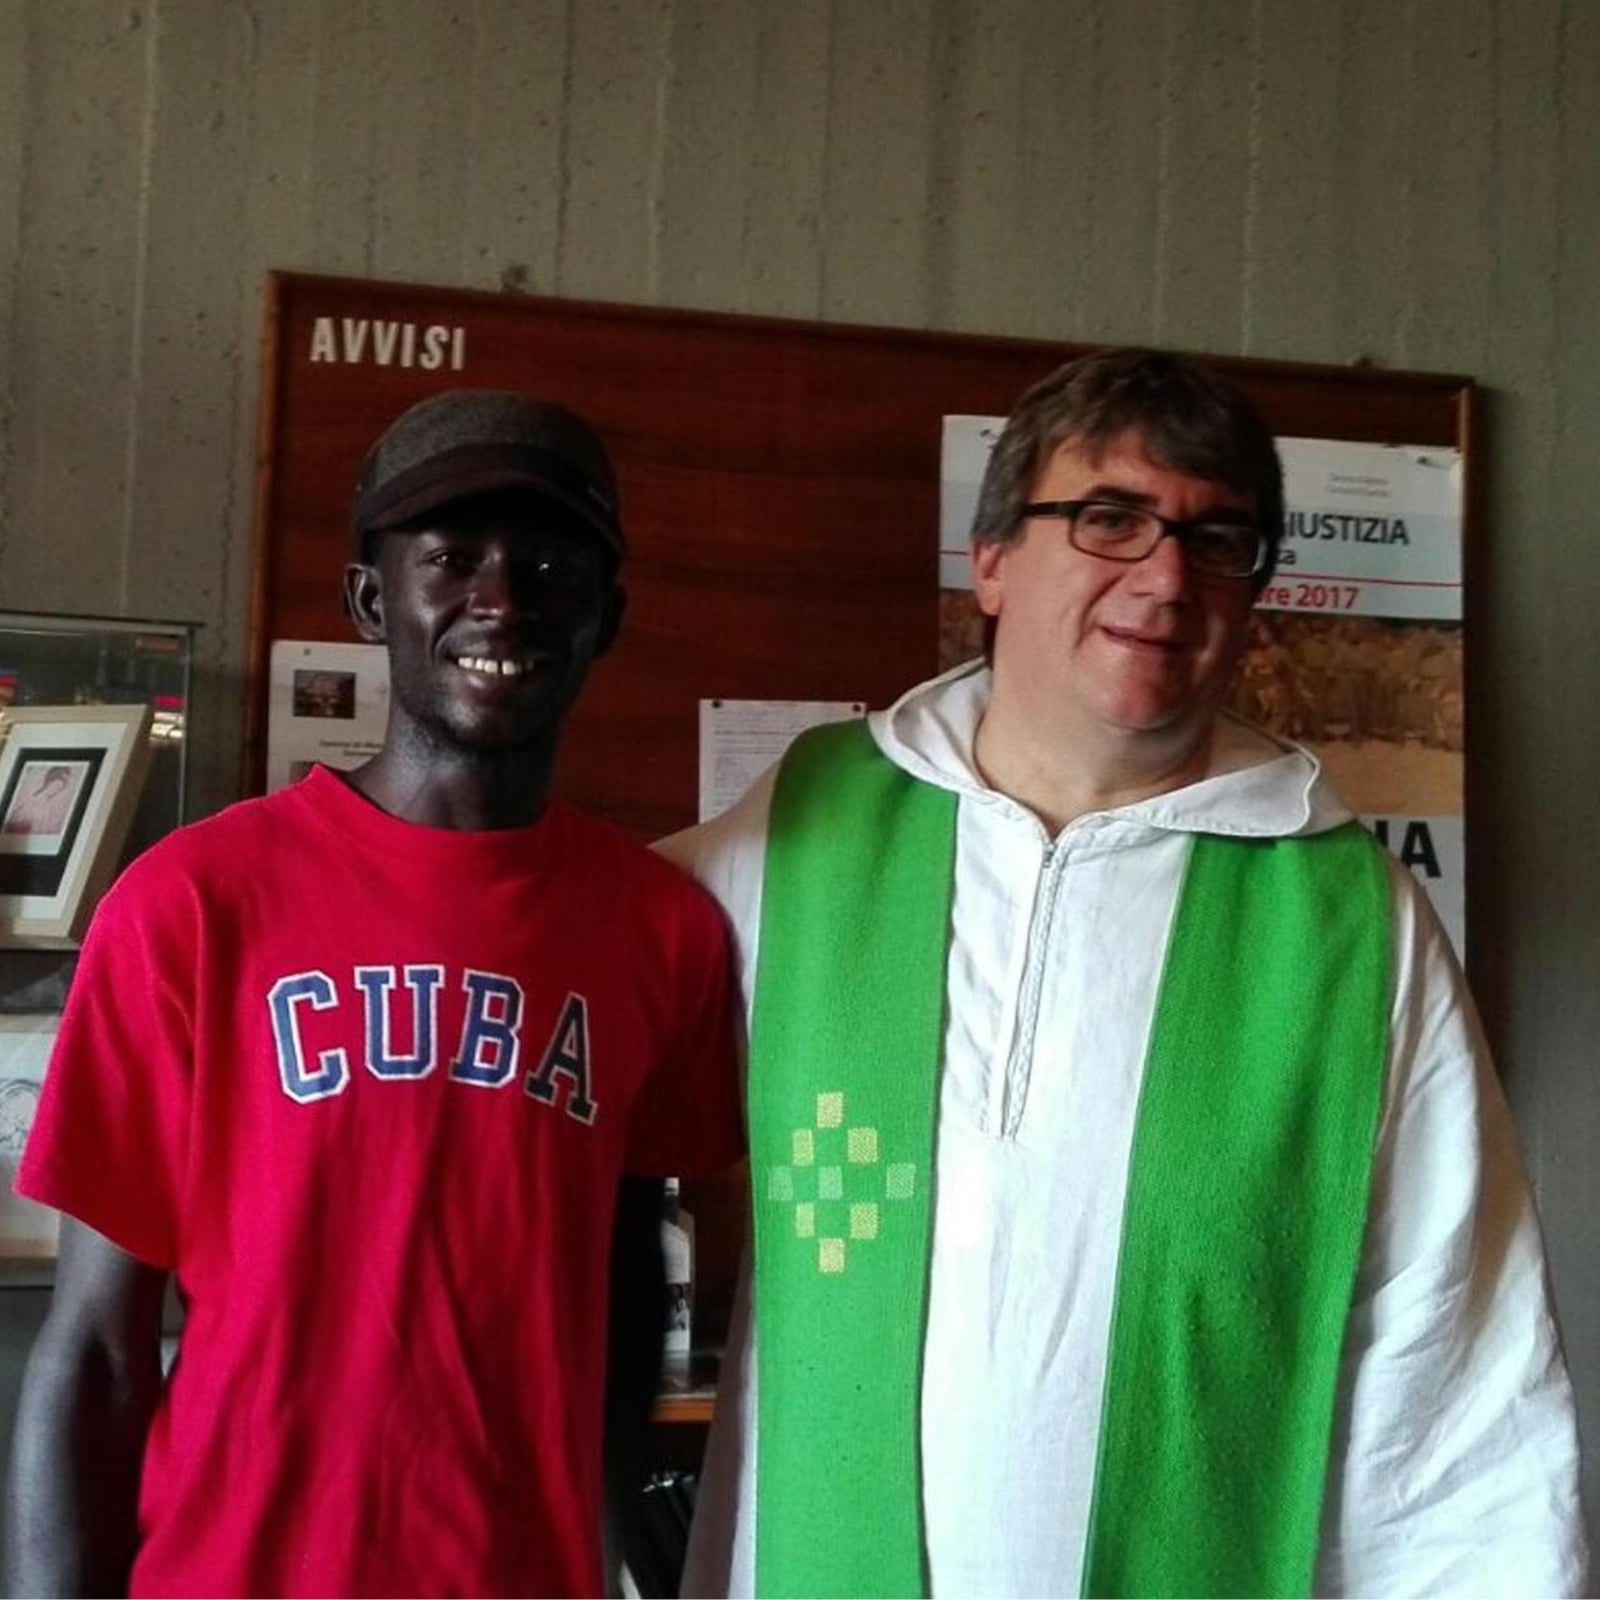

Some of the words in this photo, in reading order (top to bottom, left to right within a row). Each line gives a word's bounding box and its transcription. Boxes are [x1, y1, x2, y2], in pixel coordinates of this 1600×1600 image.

[309, 316, 466, 371] AVVISI
[1283, 511, 1409, 545] IUSTIZIA
[1296, 583, 1360, 610] 2017
[266, 963, 599, 1126] CUBA
